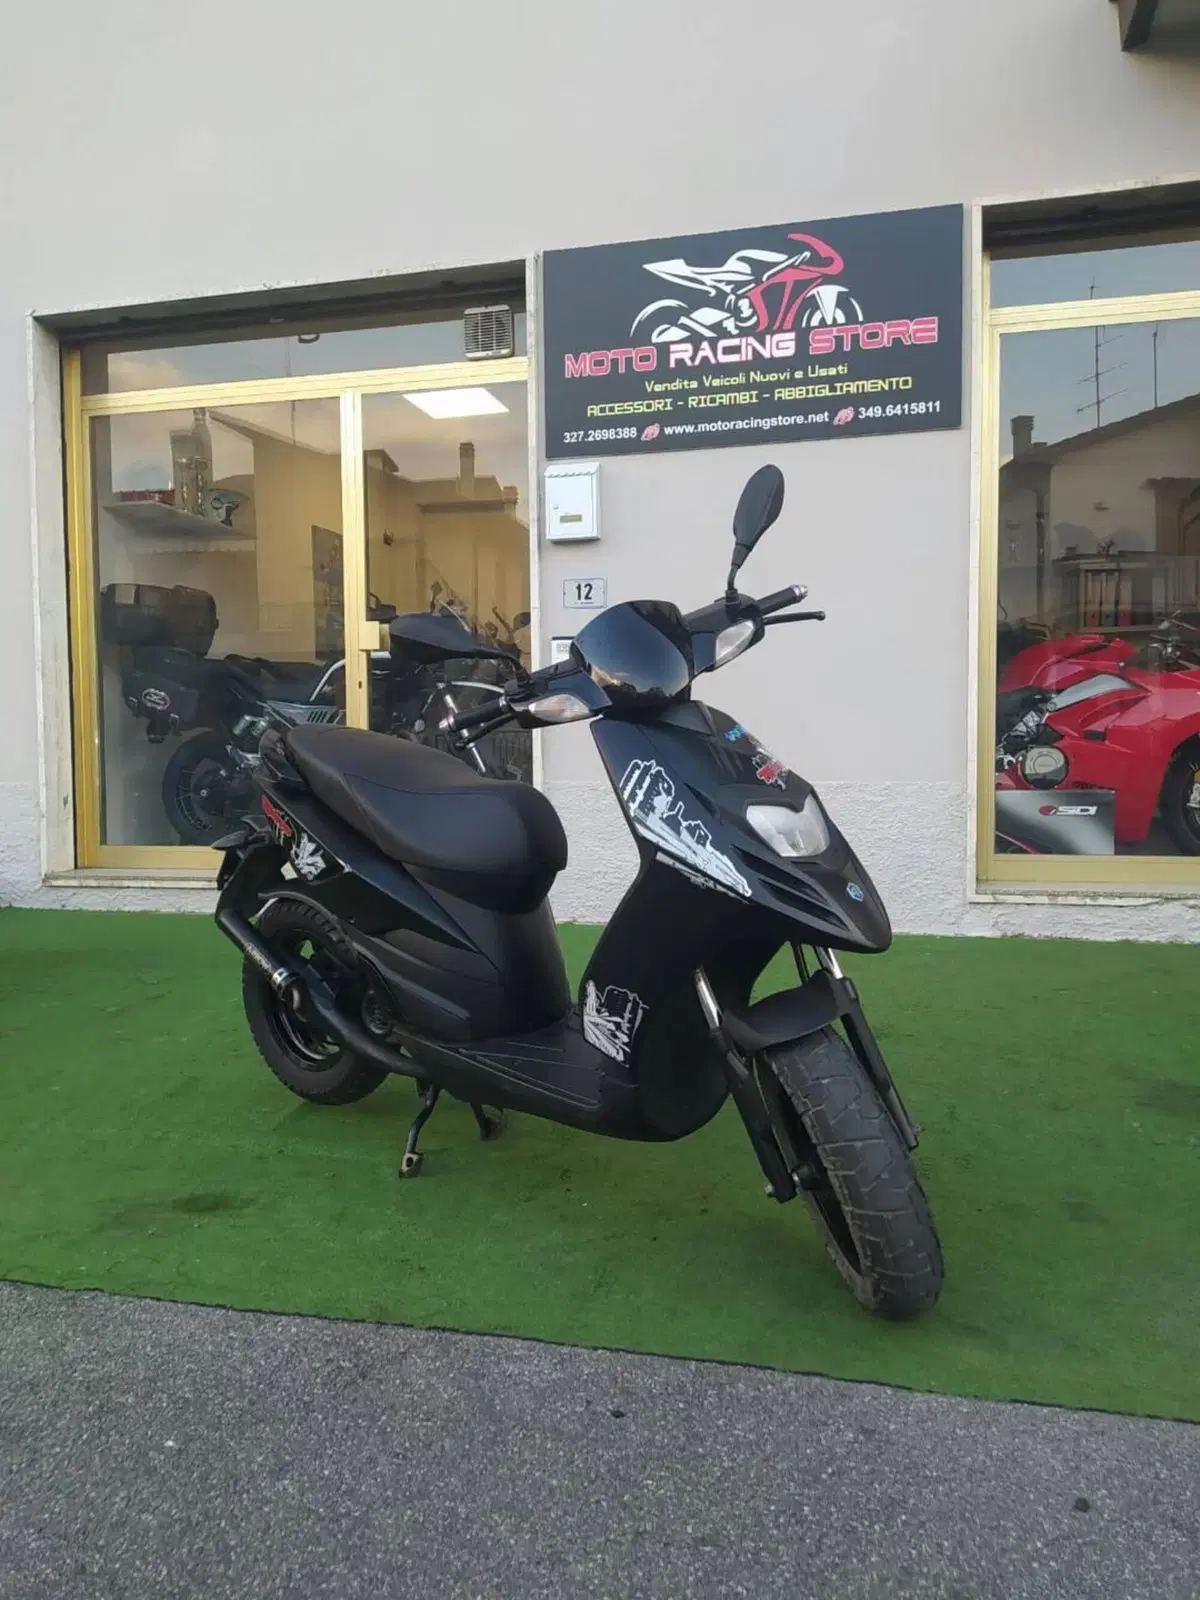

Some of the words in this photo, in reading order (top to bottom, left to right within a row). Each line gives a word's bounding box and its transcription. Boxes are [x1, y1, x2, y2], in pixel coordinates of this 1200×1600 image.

[565, 346, 657, 378] MOTO
[669, 332, 796, 369] RACING
[809, 316, 938, 355] STORE
[587, 399, 673, 417] ACCESSORI
[688, 391, 759, 408] RICAMBI
[774, 376, 912, 400] ABBIGLIAMENTO
[645, 377, 698, 392] Vendita
[703, 371, 746, 387] Veicoli
[750, 369, 790, 383] Nuovi
[794, 371, 804, 379] e
[808, 363, 848, 378] Usati
[563, 427, 638, 443] 327.2698388
[664, 411, 829, 435] www.motoracingstore.net
[858, 401, 941, 419] 349.6415811
[575, 583, 593, 600] 12
